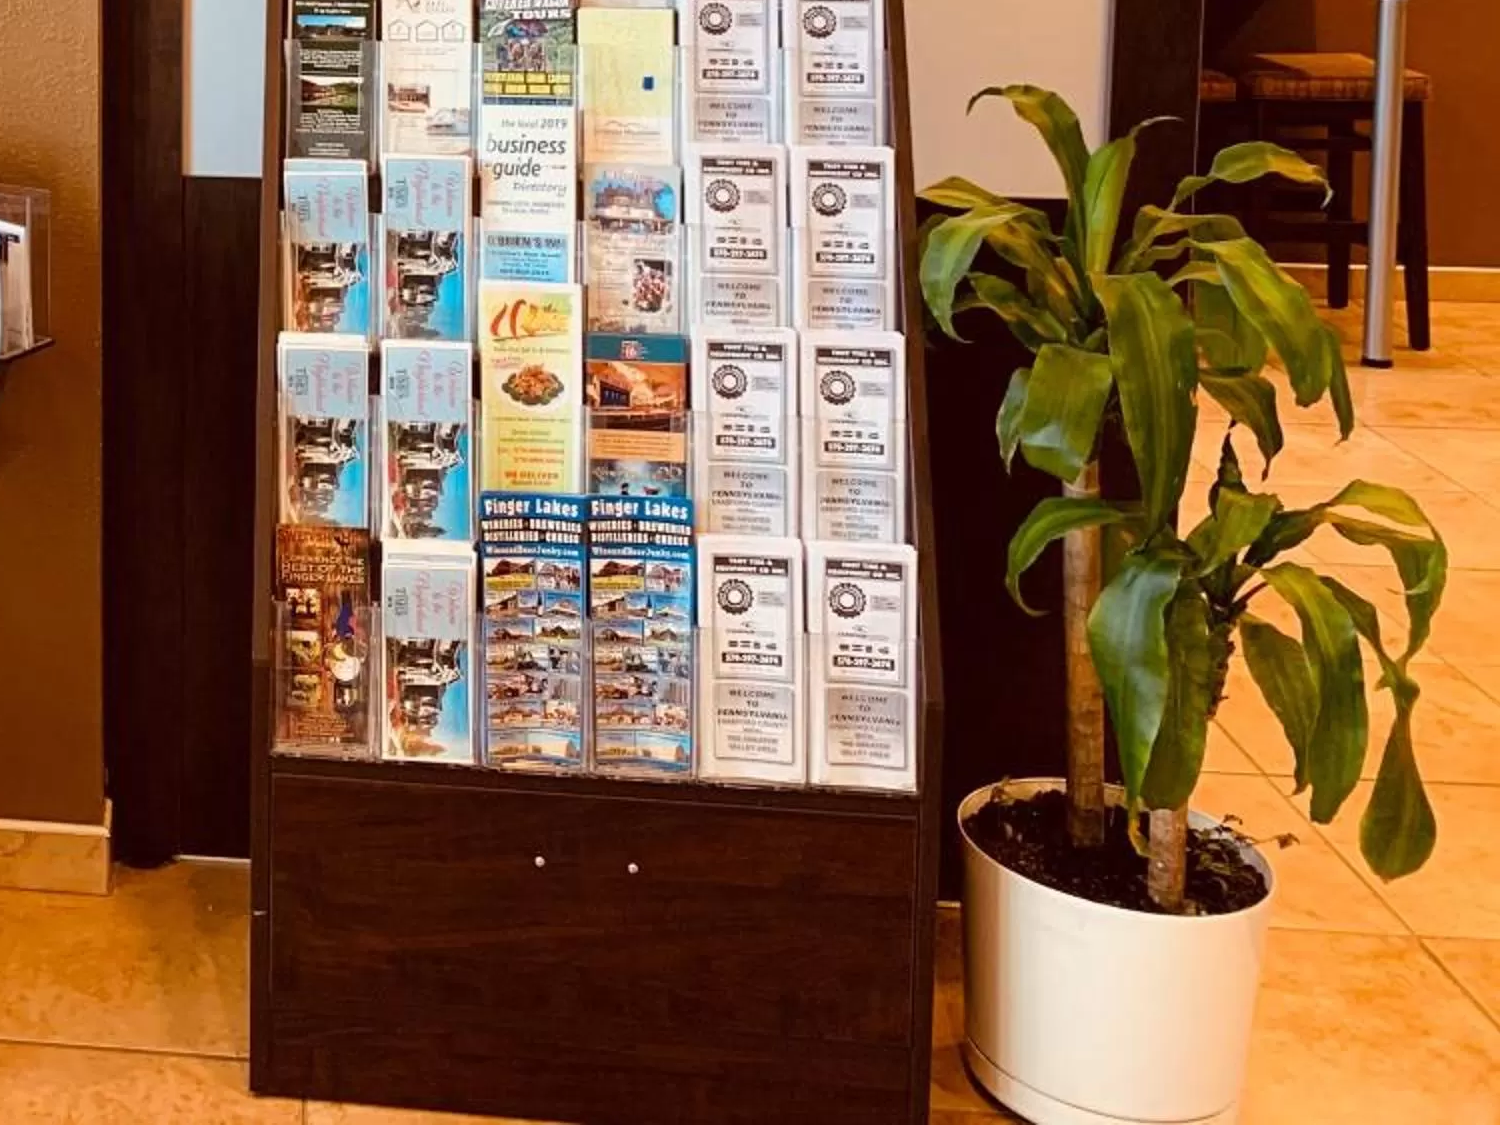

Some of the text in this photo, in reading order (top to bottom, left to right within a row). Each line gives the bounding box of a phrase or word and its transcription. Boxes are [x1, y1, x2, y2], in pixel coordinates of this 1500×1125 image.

[510, 10, 572, 20] TOURS
[540, 118, 568, 129] 2019
[486, 132, 567, 155] business
[492, 157, 542, 181] guide
[484, 498, 579, 518] Finger Lakes
[590, 498, 689, 521] Finger Lakes
[728, 689, 777, 700] WELCOME
[841, 694, 889, 705] WELCOME
[746, 700, 759, 708] TO
[858, 704, 872, 713] TO
